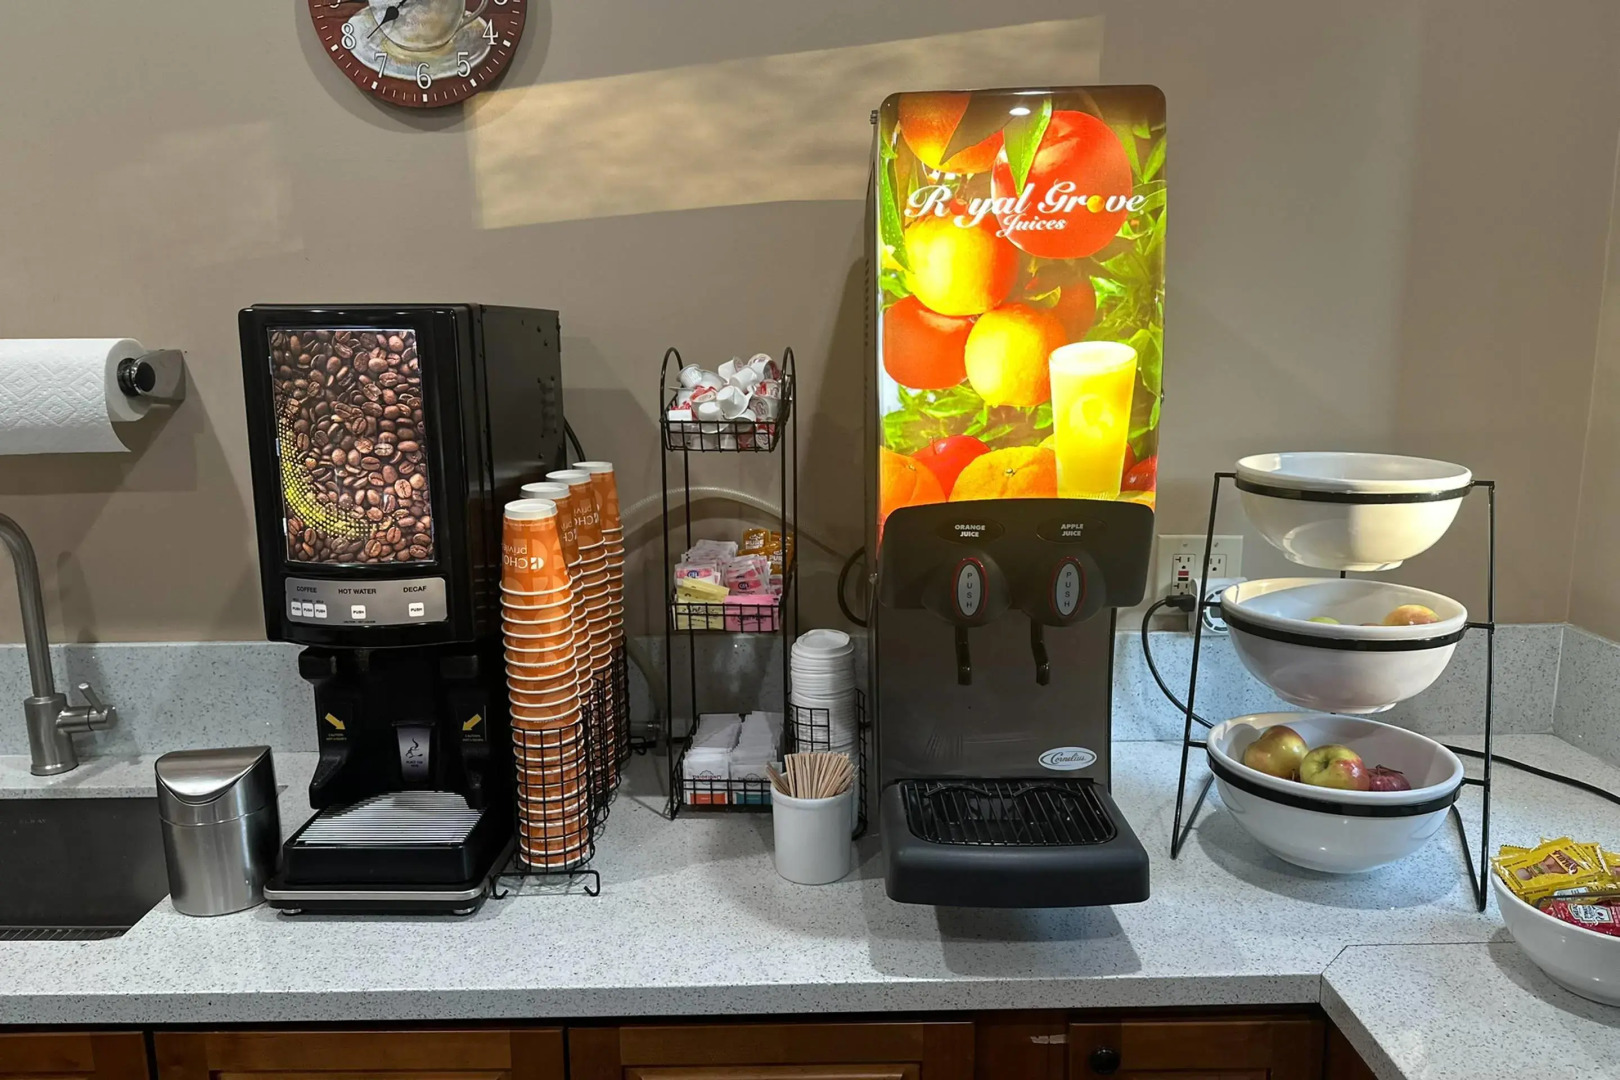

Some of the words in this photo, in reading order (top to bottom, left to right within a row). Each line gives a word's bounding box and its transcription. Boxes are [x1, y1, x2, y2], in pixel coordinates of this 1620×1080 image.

[340, 22, 356, 49] 8
[482, 19, 499, 46] 4
[374, 52, 387, 78] 7
[416, 62, 431, 89] 6
[457, 51, 471, 78] 5
[996, 213, 1068, 237] Juices
[296, 585, 318, 593] COFFEE
[403, 585, 427, 593] DECAF
[966, 572, 974, 608] PUSH
[1064, 571, 1072, 608] PUSH
